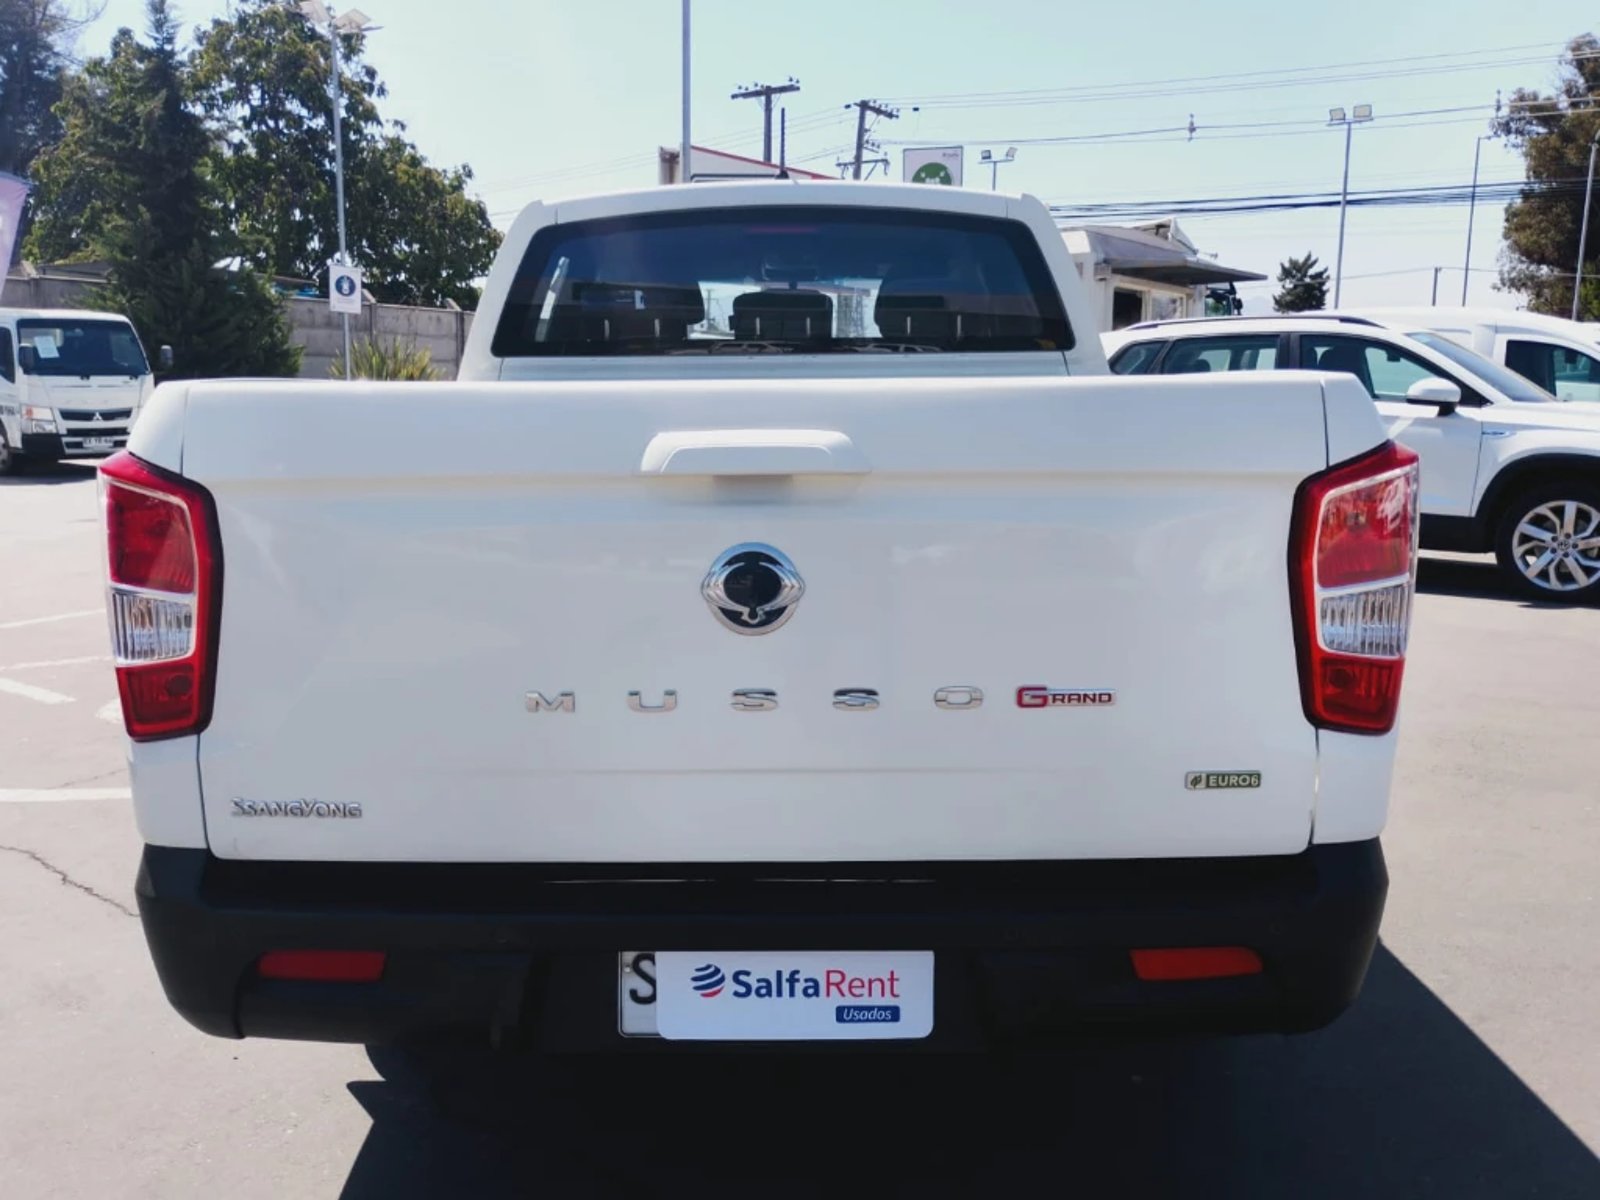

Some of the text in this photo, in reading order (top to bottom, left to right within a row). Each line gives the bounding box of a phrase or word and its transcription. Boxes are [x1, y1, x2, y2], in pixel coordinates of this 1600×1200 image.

[525, 688, 984, 712] MUSSO
[1208, 774, 1259, 787] EURO6
[842, 1007, 892, 1021] Usados
